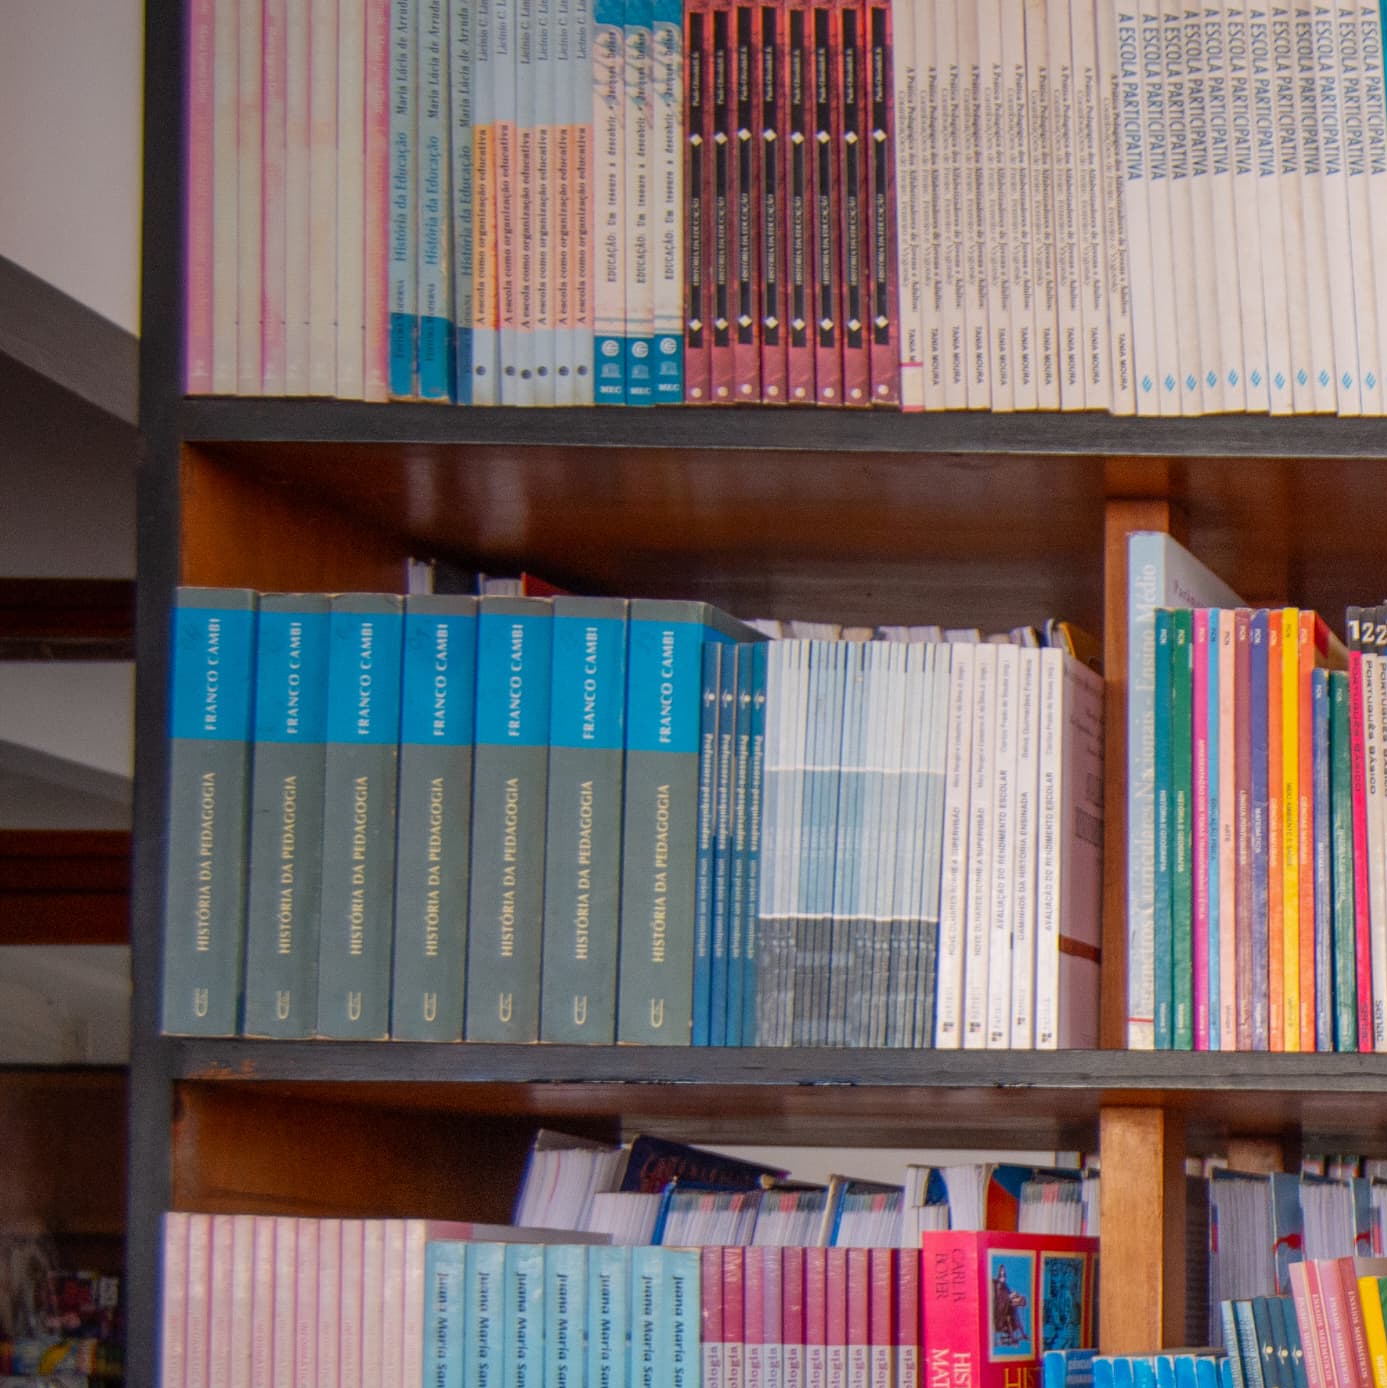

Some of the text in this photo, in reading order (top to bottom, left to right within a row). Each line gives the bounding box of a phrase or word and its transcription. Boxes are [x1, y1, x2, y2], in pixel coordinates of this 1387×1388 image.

[1116, 12, 1144, 180] A ESCOLA PARTICIPATIVA
[1349, 620, 1360, 640] 1
[1361, 622, 1375, 642] 2
[1375, 624, 1387, 646] 2
[658, 630, 675, 742] FRANCO CAMBI
[649, 783, 670, 962] HISTÓRIA DA PEDAGOGIA
[672, 1276, 685, 1315] Juana
[673, 1321, 686, 1363] María
